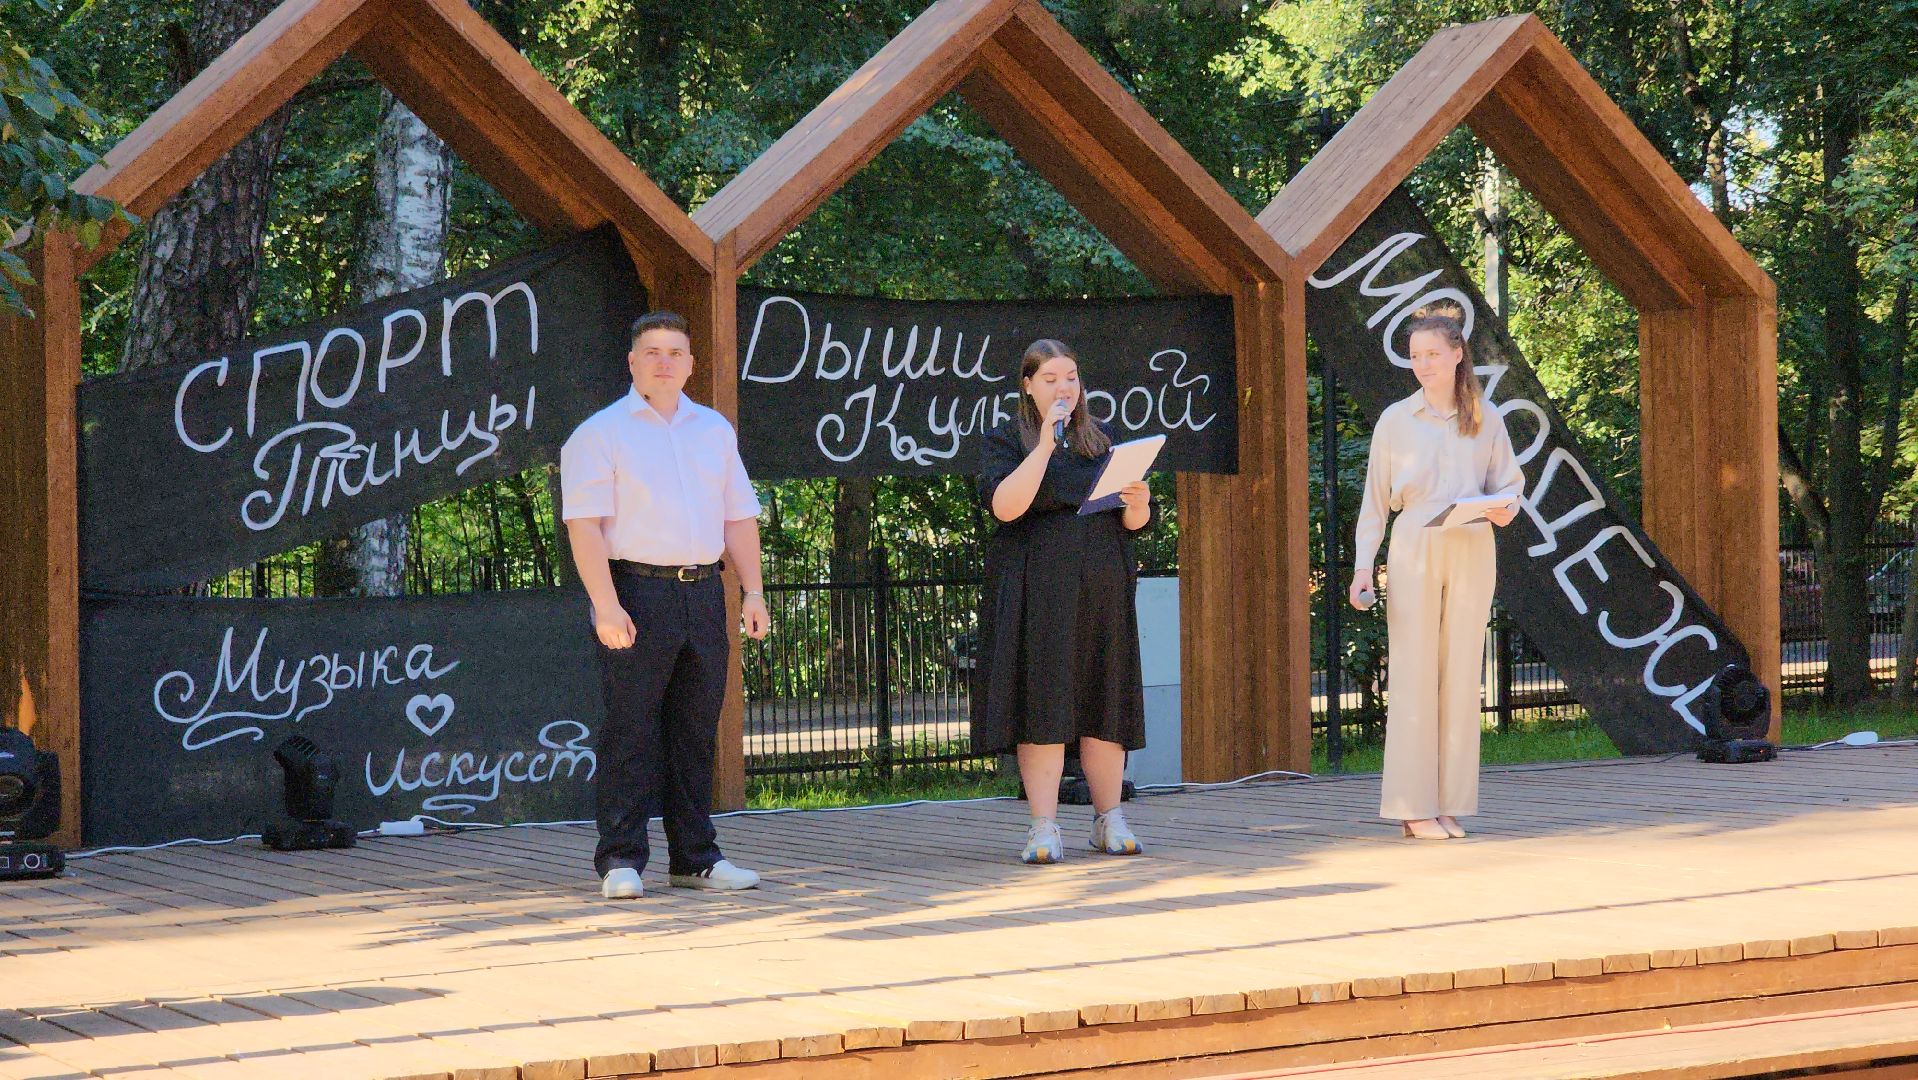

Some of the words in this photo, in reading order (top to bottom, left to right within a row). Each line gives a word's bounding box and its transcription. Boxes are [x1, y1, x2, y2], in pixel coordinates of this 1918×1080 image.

[741, 296, 1006, 383] Дыши
[240, 385, 536, 532] Танцы
[815, 348, 1218, 466] Кульрой
[153, 626, 461, 751] Музыка
[364, 719, 598, 815] Искусст
